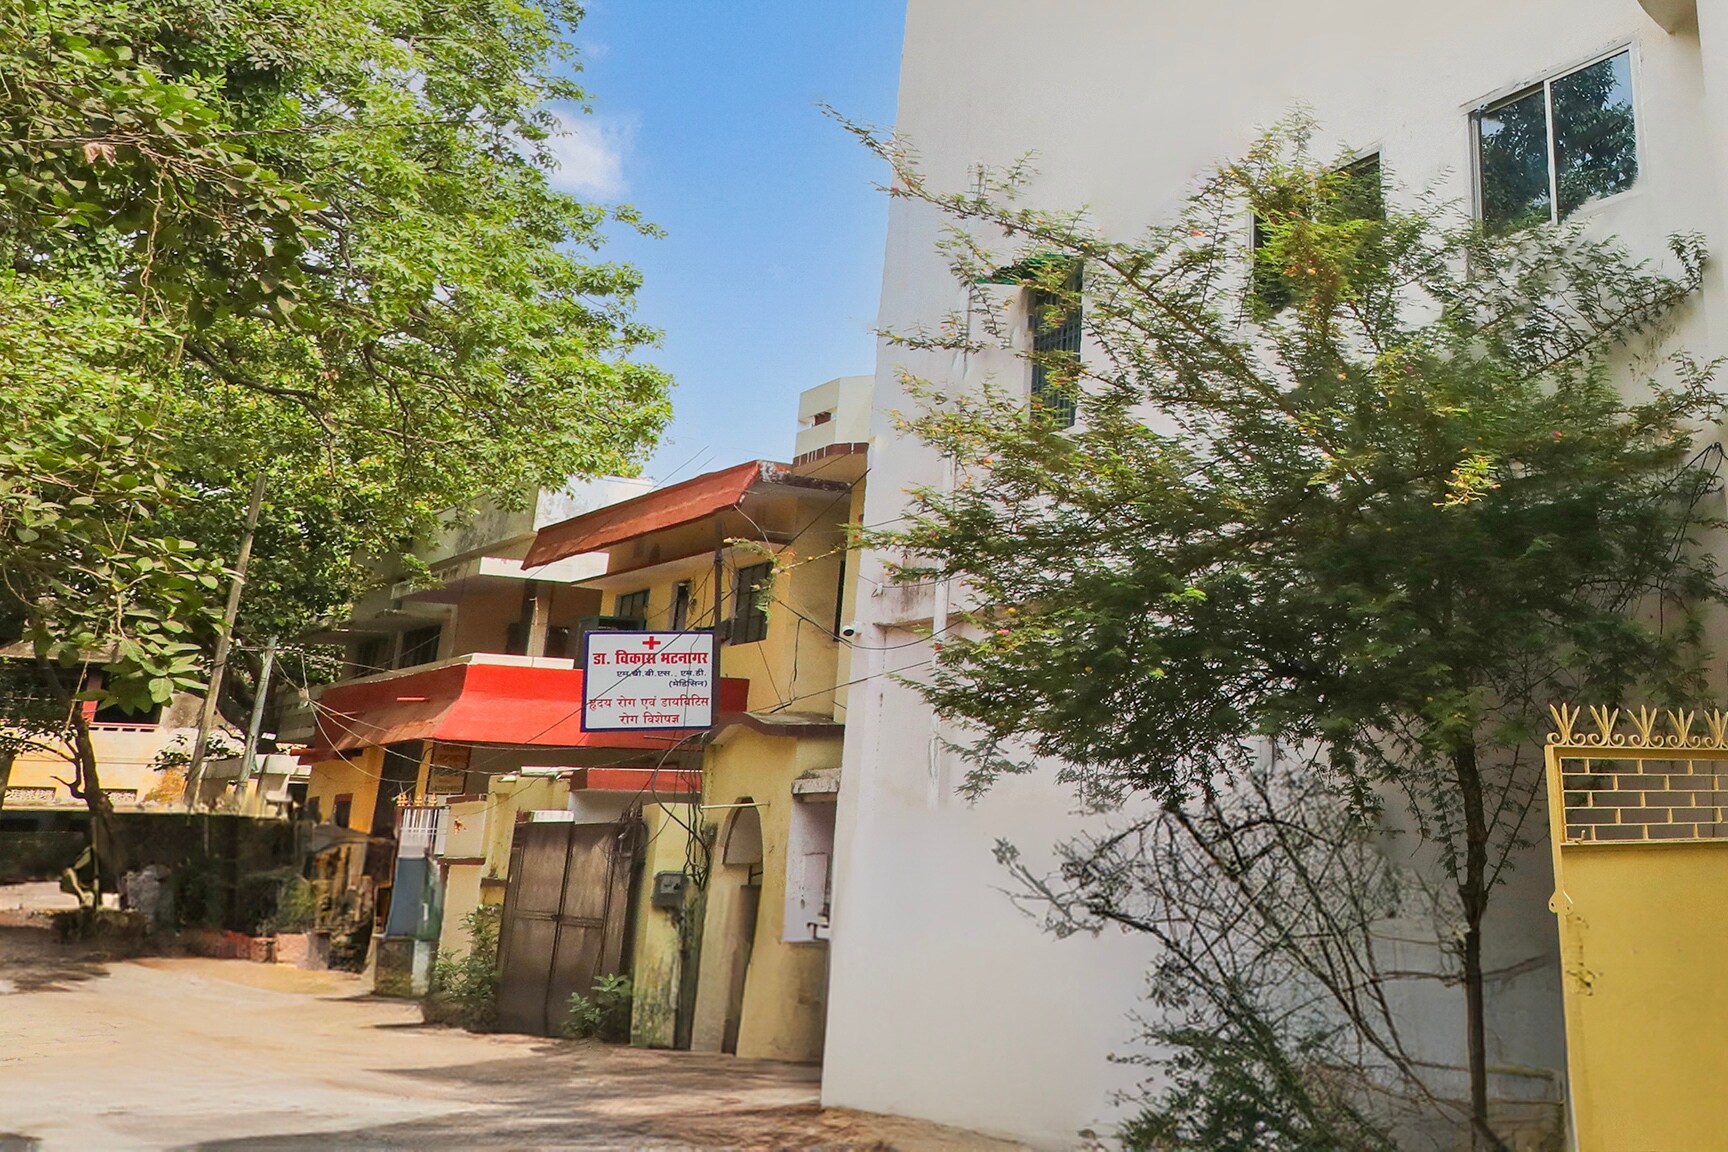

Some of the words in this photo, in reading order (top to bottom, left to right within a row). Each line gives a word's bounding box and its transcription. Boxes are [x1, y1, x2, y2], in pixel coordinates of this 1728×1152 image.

[592, 653, 610, 664] डा.
[615, 649, 656, 664] विकास
[661, 653, 708, 664] भटनागर
[616, 696, 636, 707] रोग
[640, 696, 656, 709] एवं
[619, 712, 638, 725] रोग
